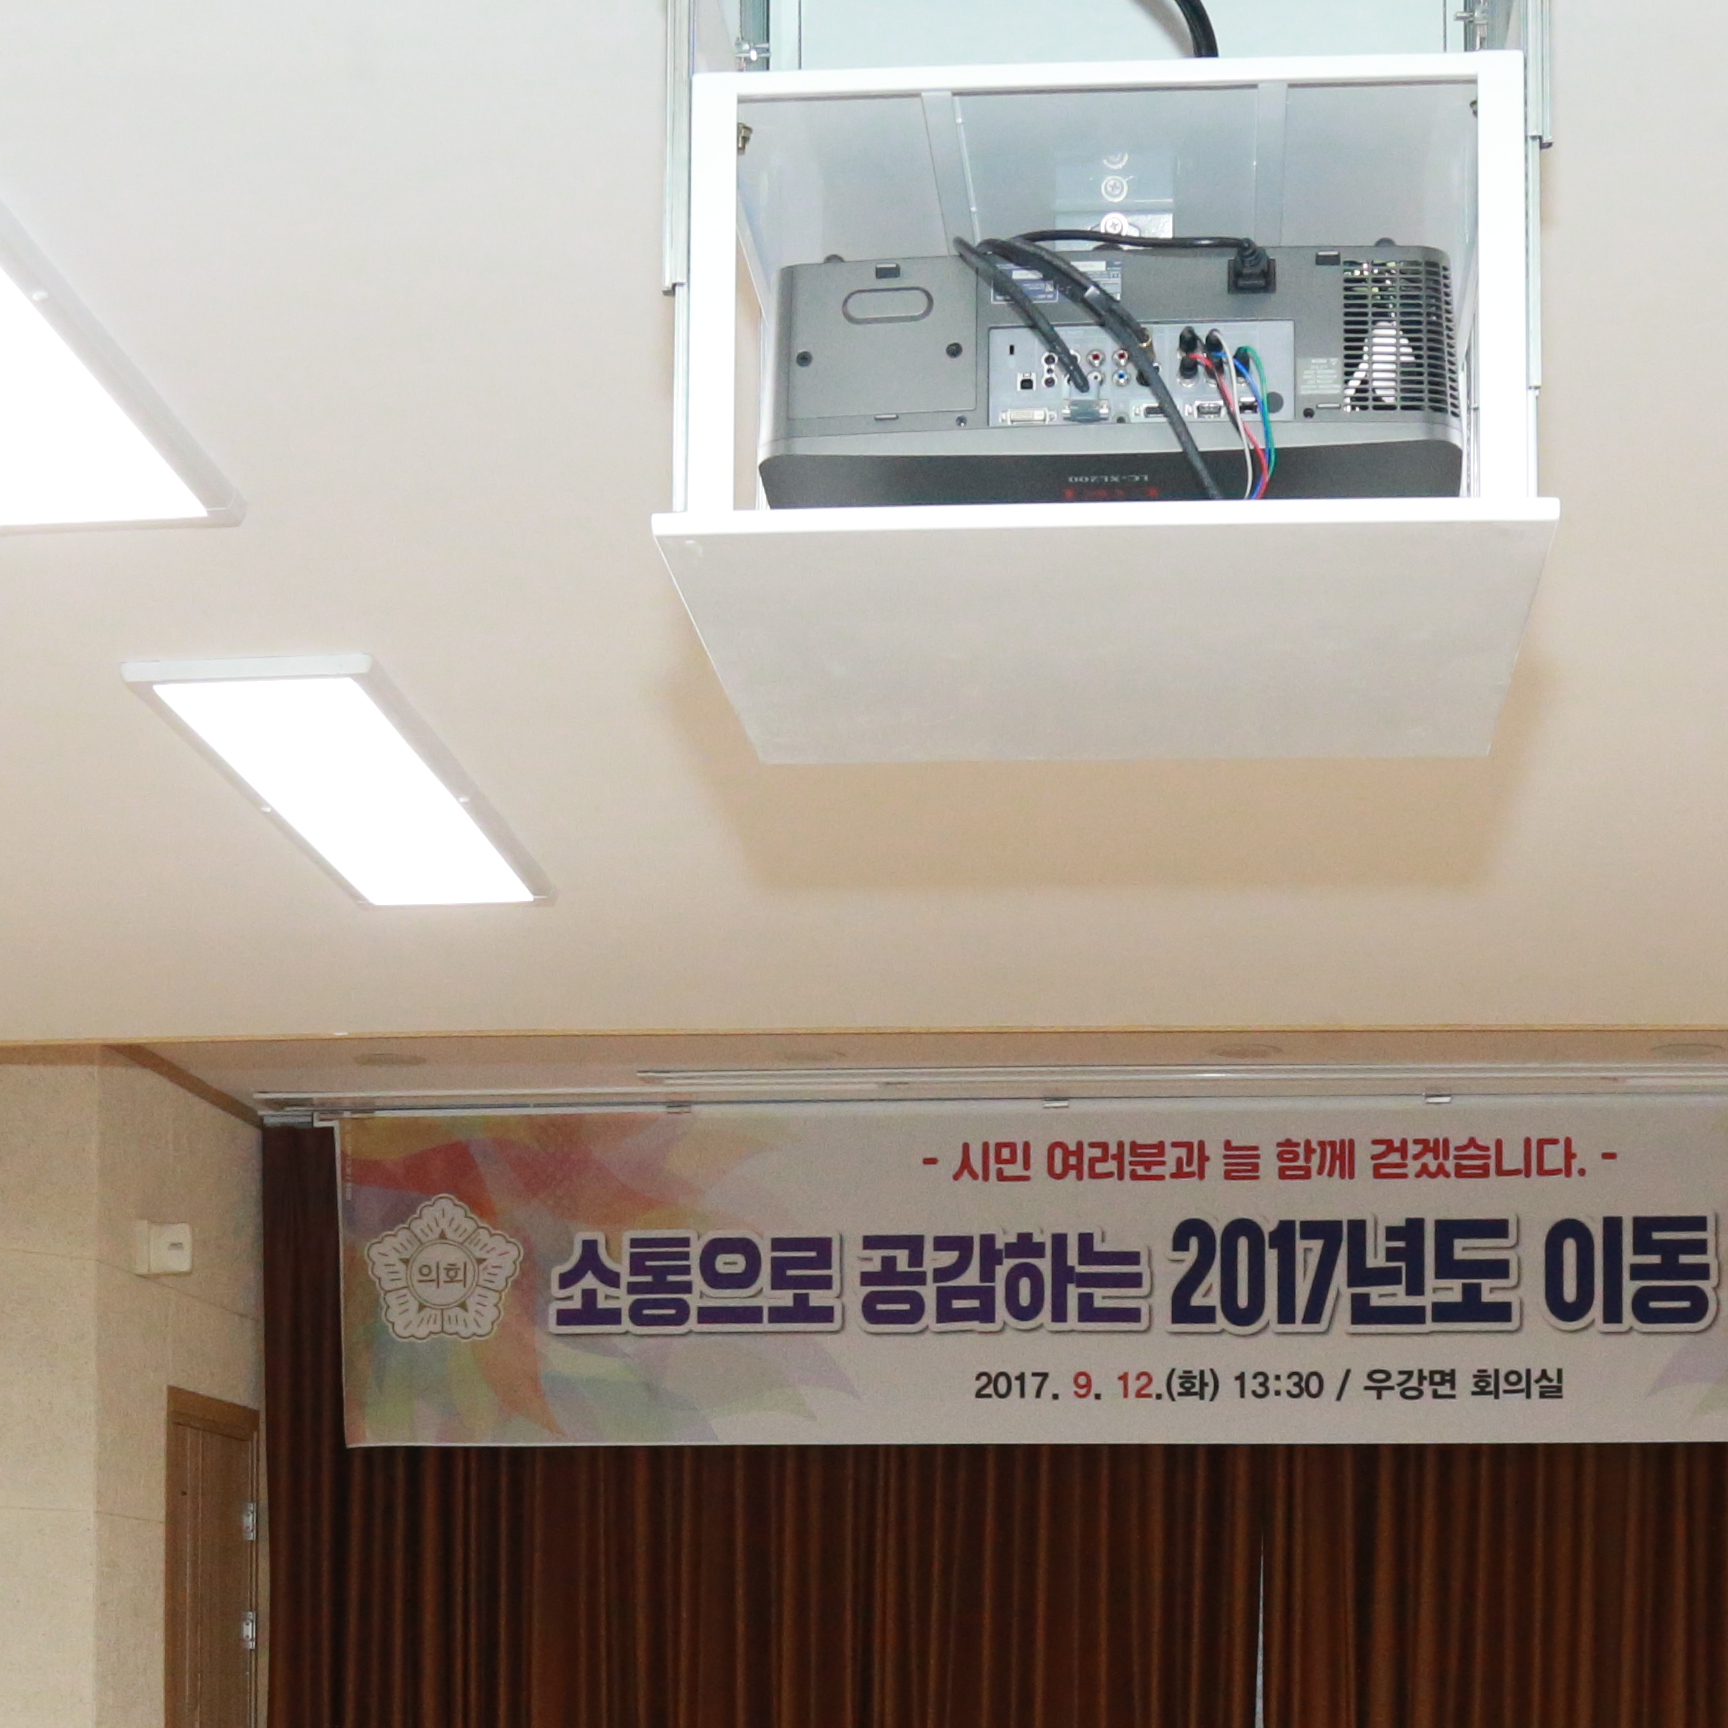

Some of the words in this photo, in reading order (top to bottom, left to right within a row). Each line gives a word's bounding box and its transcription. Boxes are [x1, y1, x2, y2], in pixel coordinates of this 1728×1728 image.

[952, 1140, 1032, 1182] 시민
[1047, 1140, 1210, 1181] 여러분과
[1223, 1139, 1260, 1181] 늘
[1276, 1138, 1355, 1180] 함께
[1370, 1136, 1587, 1179] 걷겠습니다.
[416, 1262, 469, 1290] 의회
[555, 1236, 836, 1327] 소통으로
[859, 1232, 1143, 1325] 공감하는
[1172, 1216, 1514, 1327] 2017년도
[1543, 1214, 1712, 1325] 이동
[974, 1371, 1060, 1400] 2017.
[1073, 1371, 1102, 1400] 9.
[1234, 1370, 1324, 1399] 13:30
[1335, 1368, 1352, 1402] /
[1363, 1368, 1457, 1400] 우강면
[1470, 1367, 1564, 1400] 회의실
